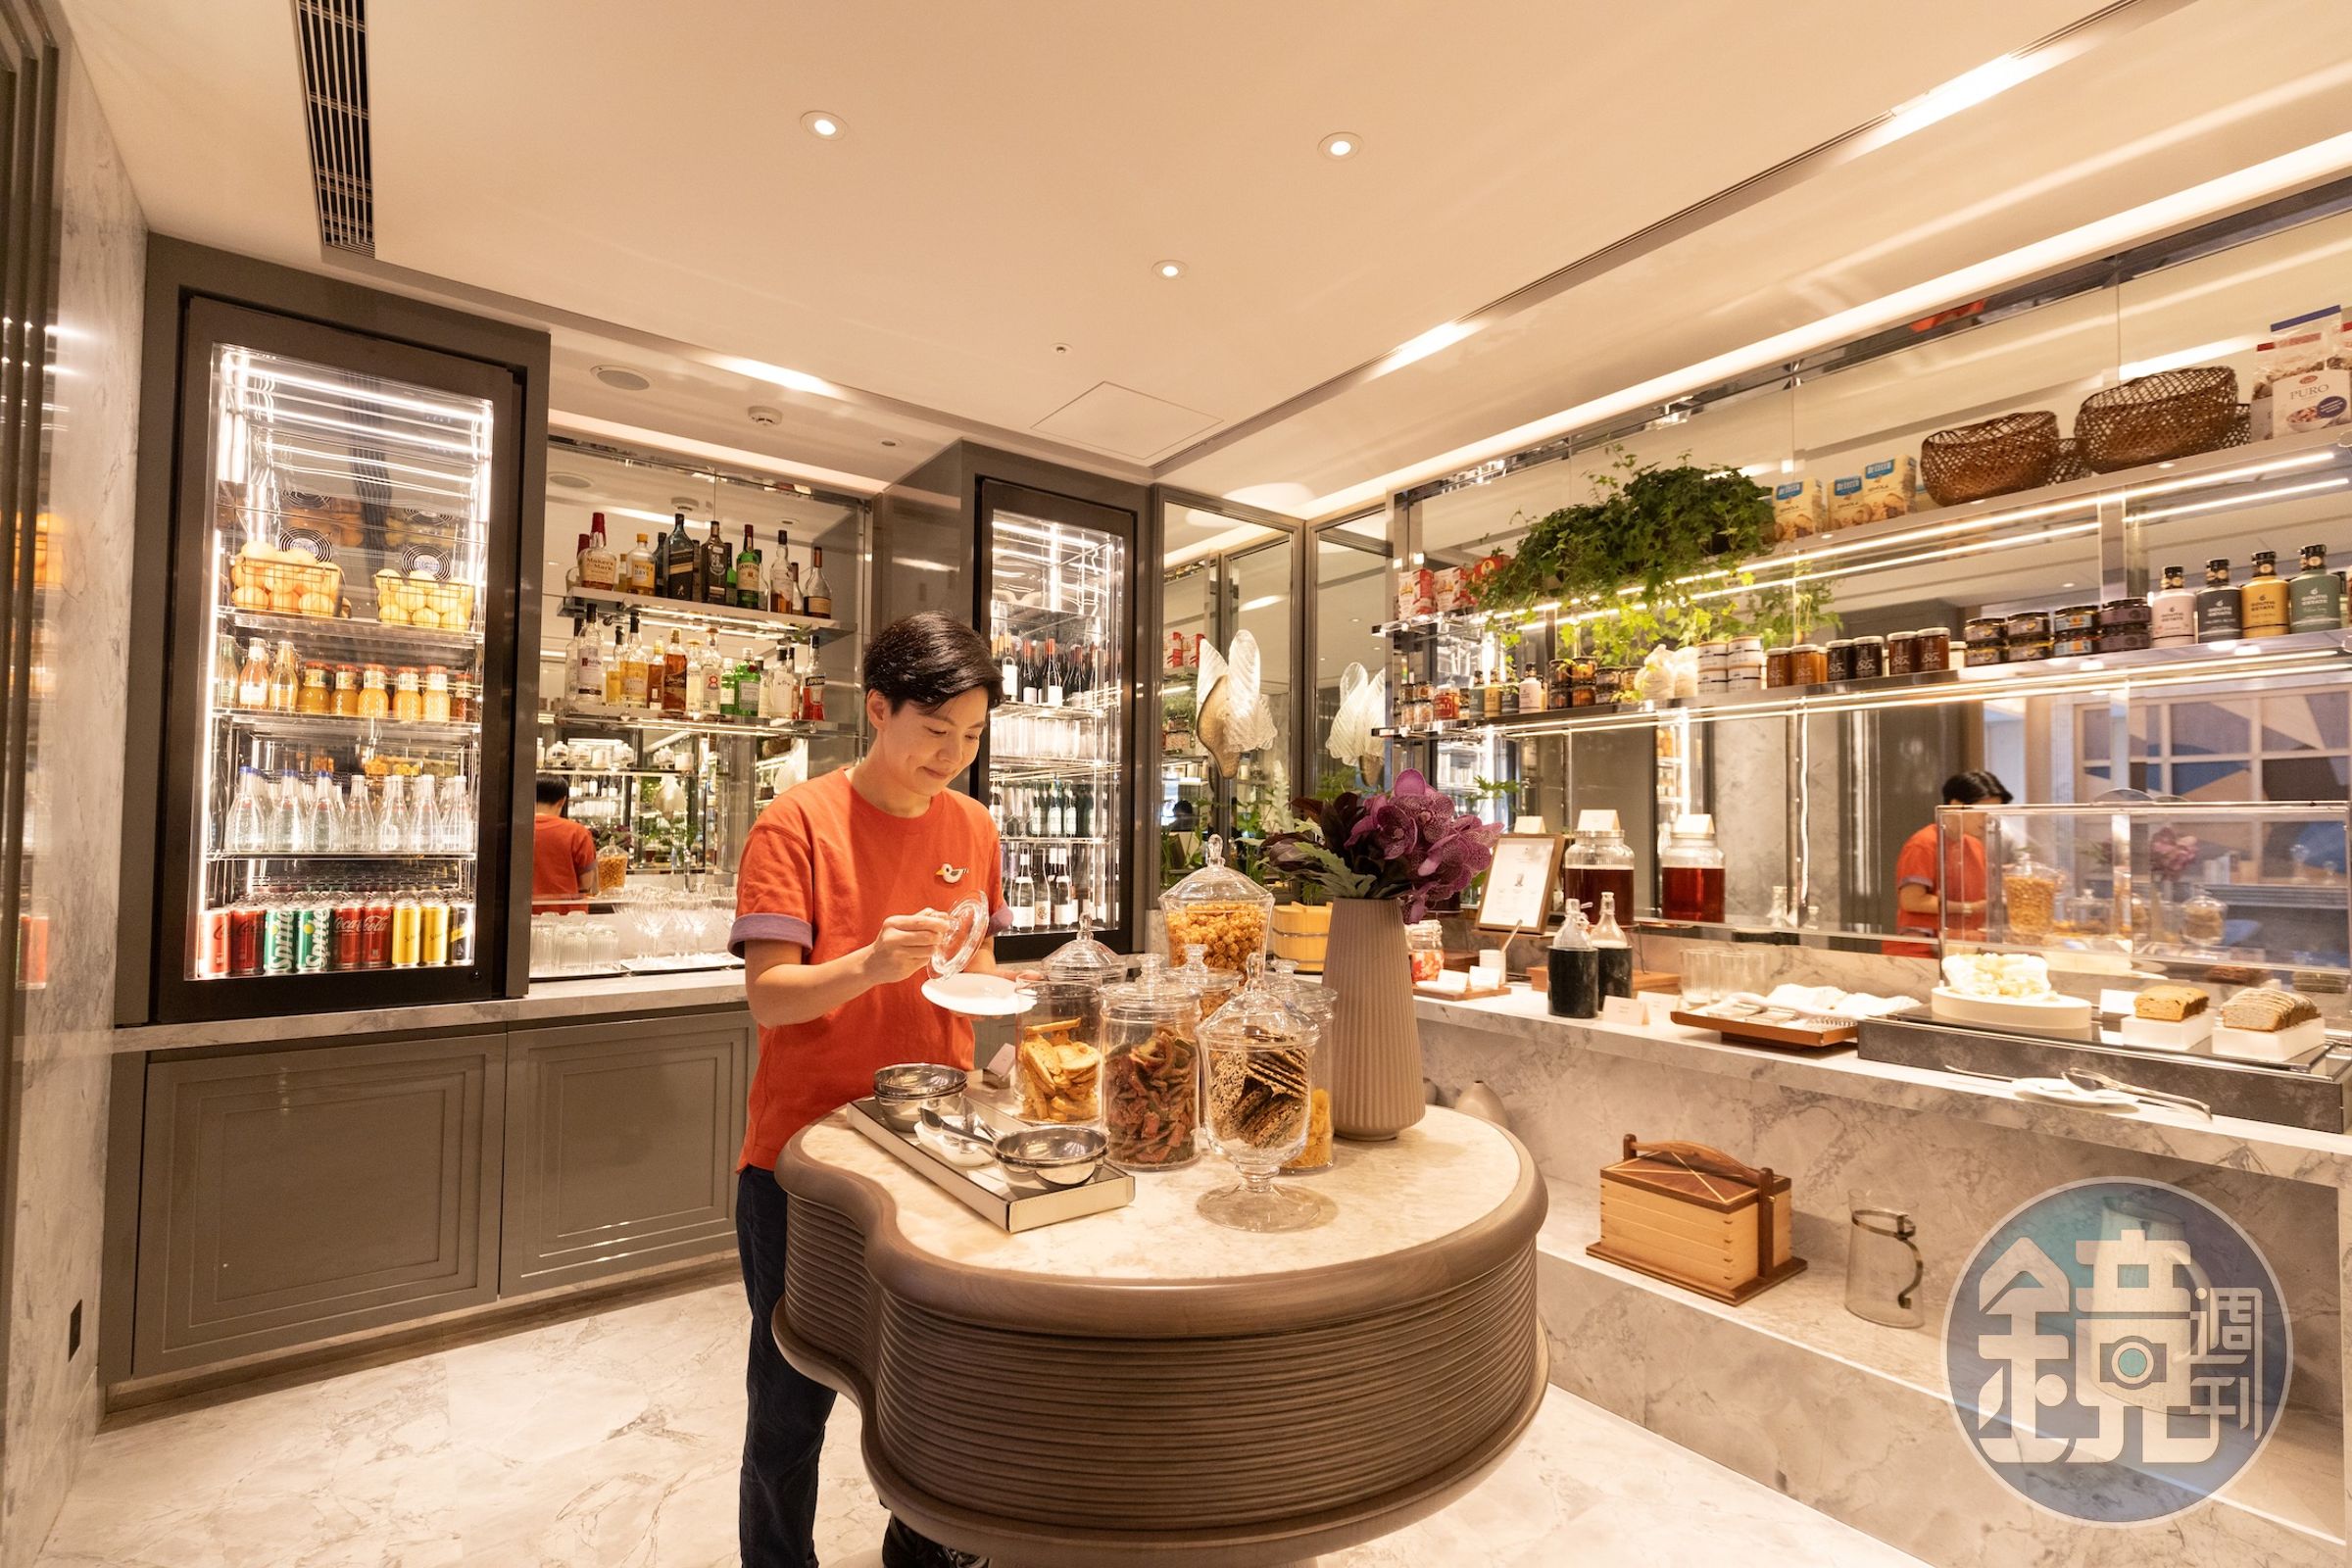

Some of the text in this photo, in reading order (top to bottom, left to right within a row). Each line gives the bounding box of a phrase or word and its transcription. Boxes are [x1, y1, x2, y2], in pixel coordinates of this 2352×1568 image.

[2289, 384, 2329, 400] PURO
[270, 909, 294, 969] Sprite
[305, 908, 330, 968] Sprite
